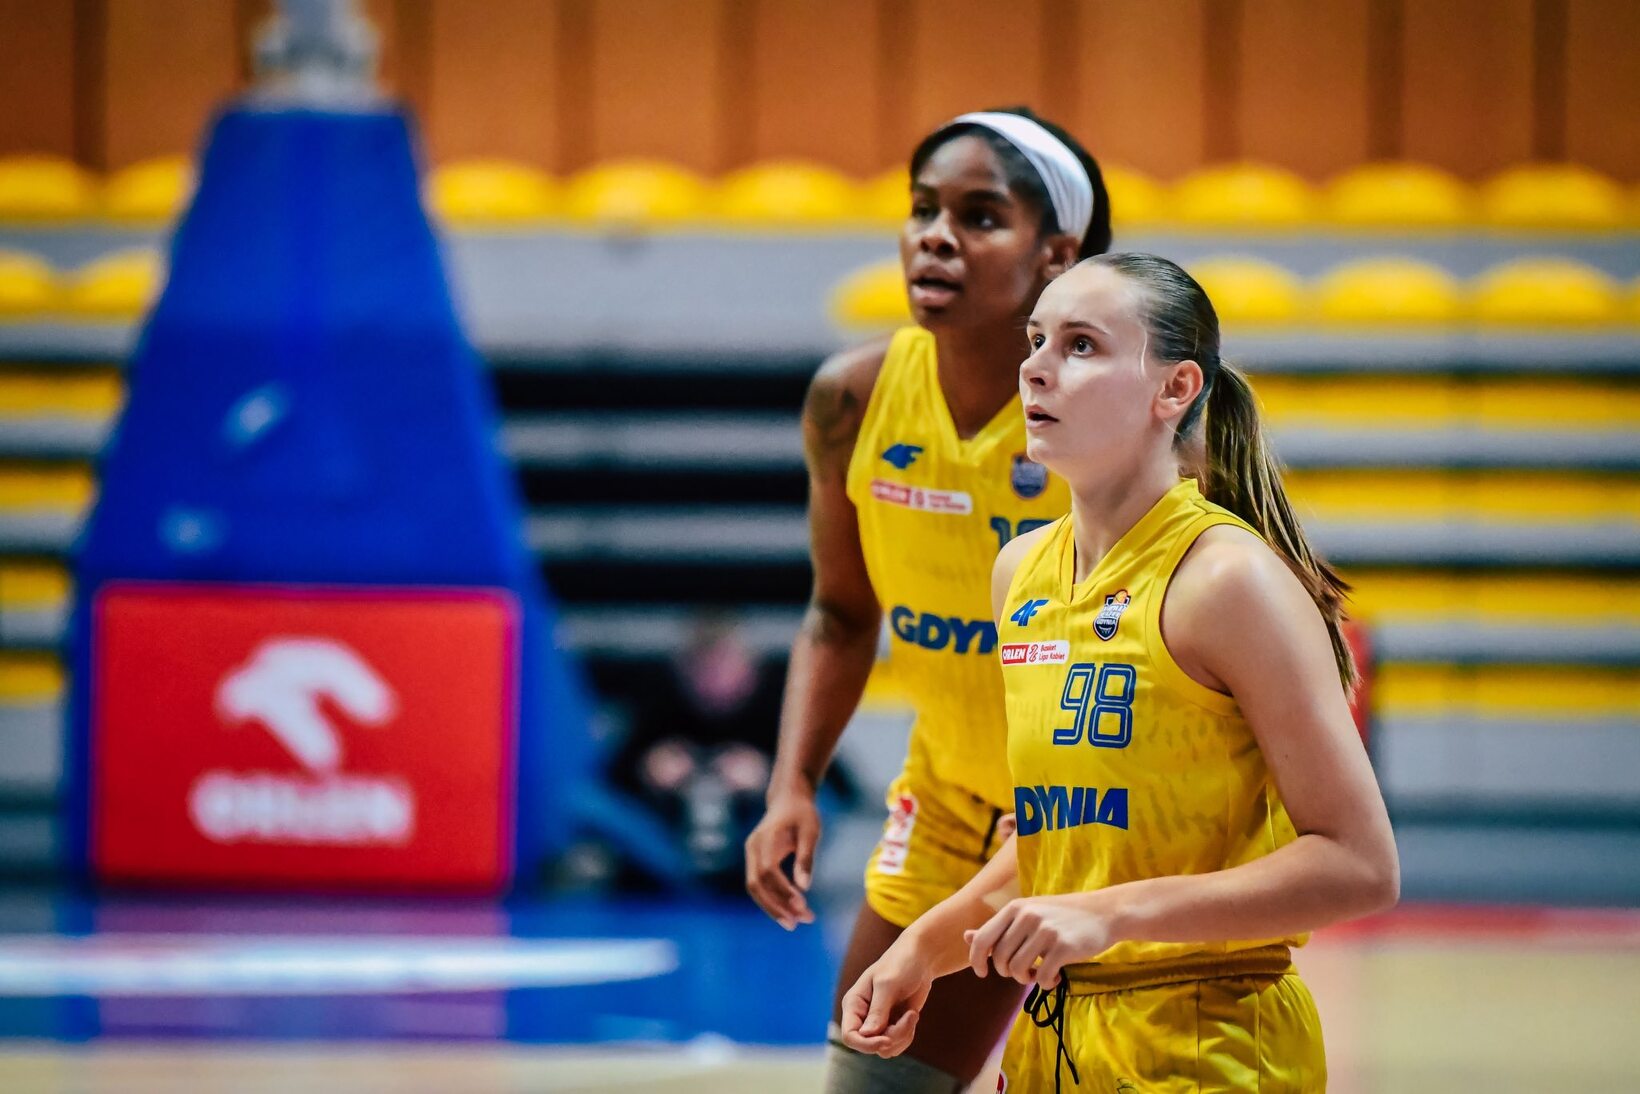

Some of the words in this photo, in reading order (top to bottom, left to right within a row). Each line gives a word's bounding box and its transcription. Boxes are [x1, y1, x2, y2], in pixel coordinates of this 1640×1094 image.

[1010, 599, 1049, 626] 4F
[1002, 648, 1026, 660] ORLEN
[1053, 663, 1136, 748] 98
